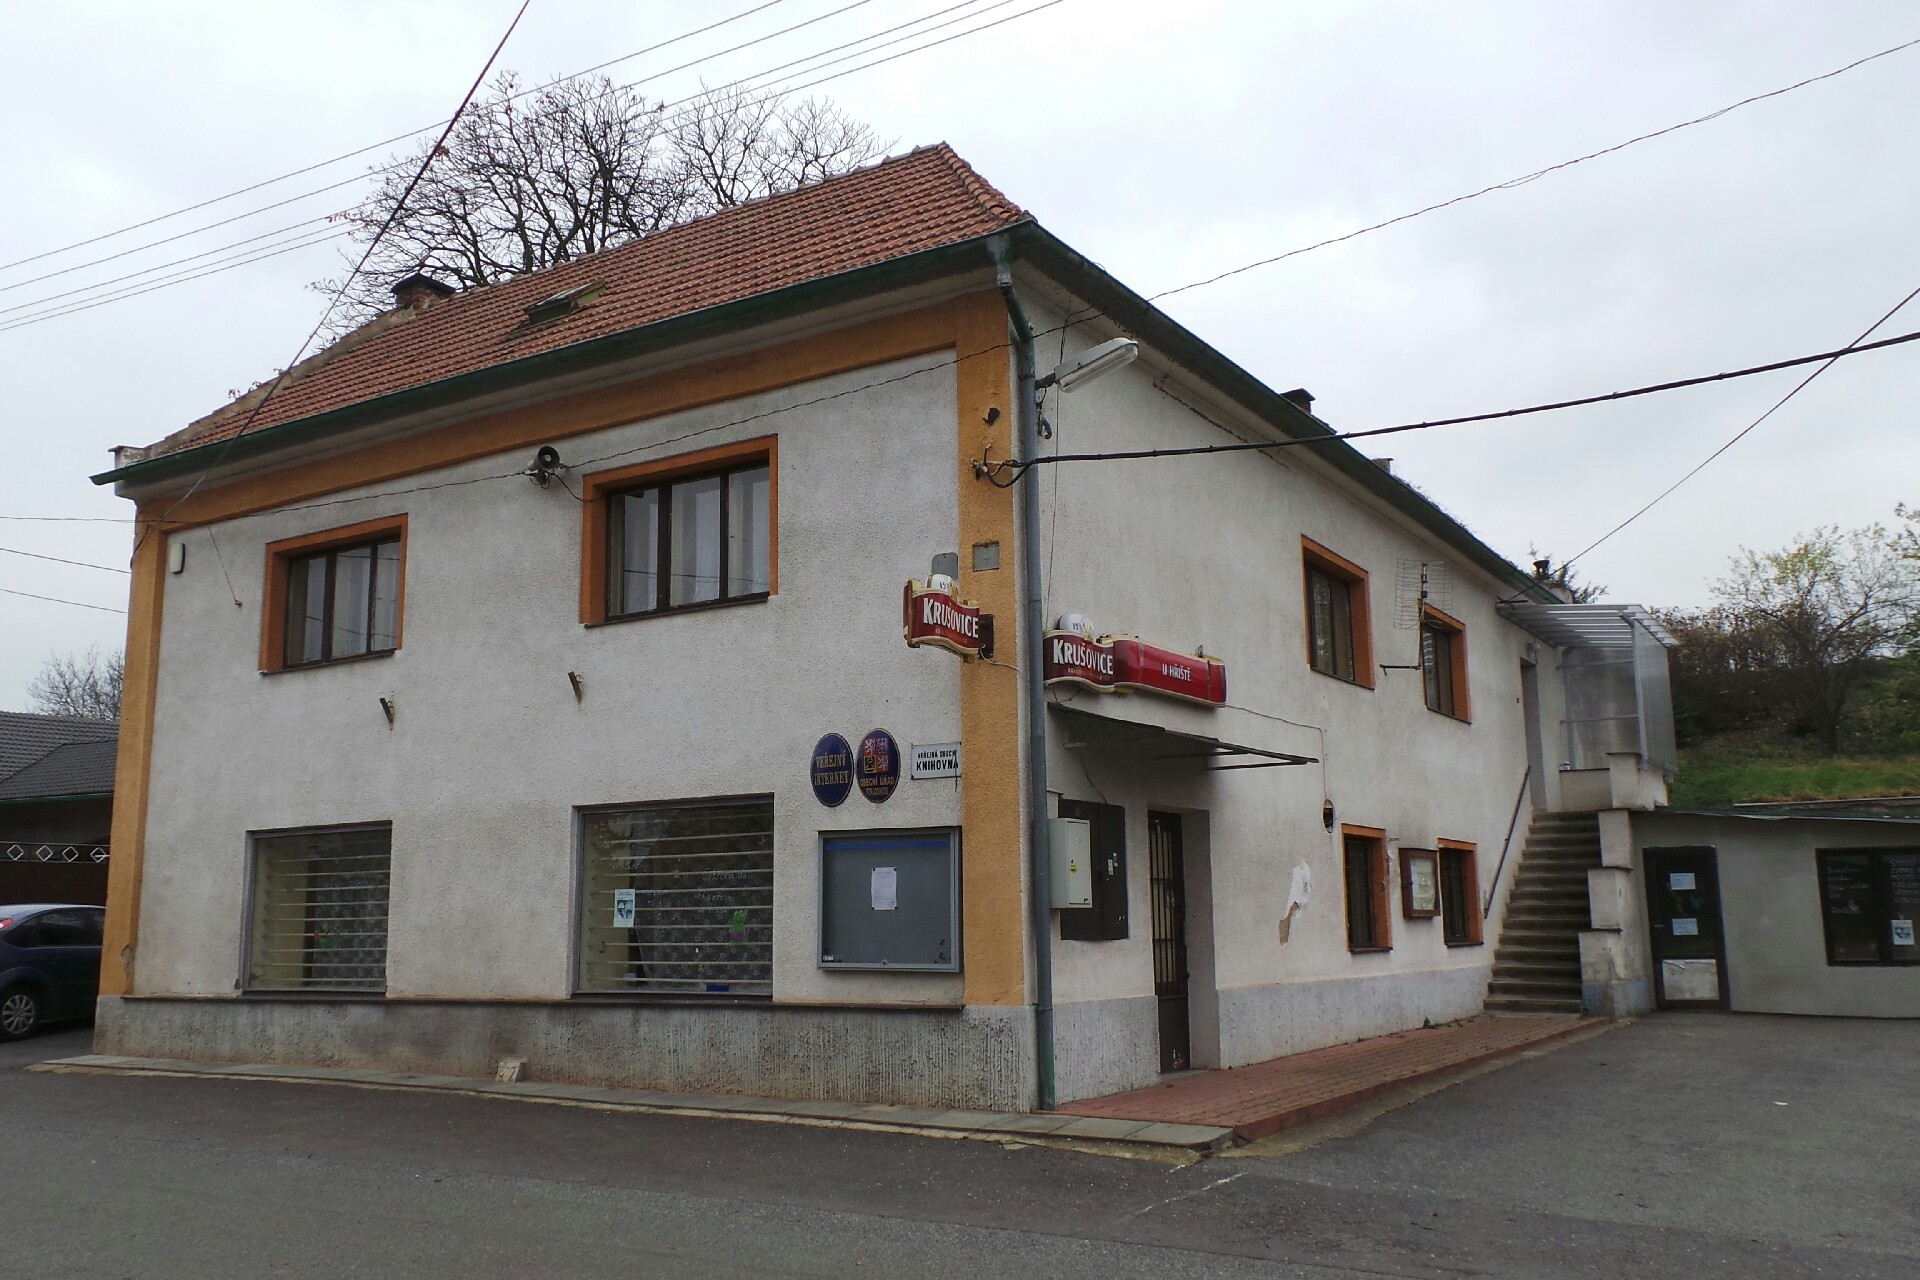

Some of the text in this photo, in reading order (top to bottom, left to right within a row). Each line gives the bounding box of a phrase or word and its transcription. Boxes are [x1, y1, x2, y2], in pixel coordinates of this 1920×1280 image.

[923, 597, 978, 639] KRUŠOVICE
[1053, 638, 1113, 675] KRUŠOVICE
[1162, 663, 1192, 682] U HŘIŠTĚ
[815, 749, 847, 769] VEŘEJNÝ
[917, 749, 938, 759] VEŘEJNÁ
[916, 759, 959, 771] KNIHOVNA
[813, 770, 849, 786] INTERNET
